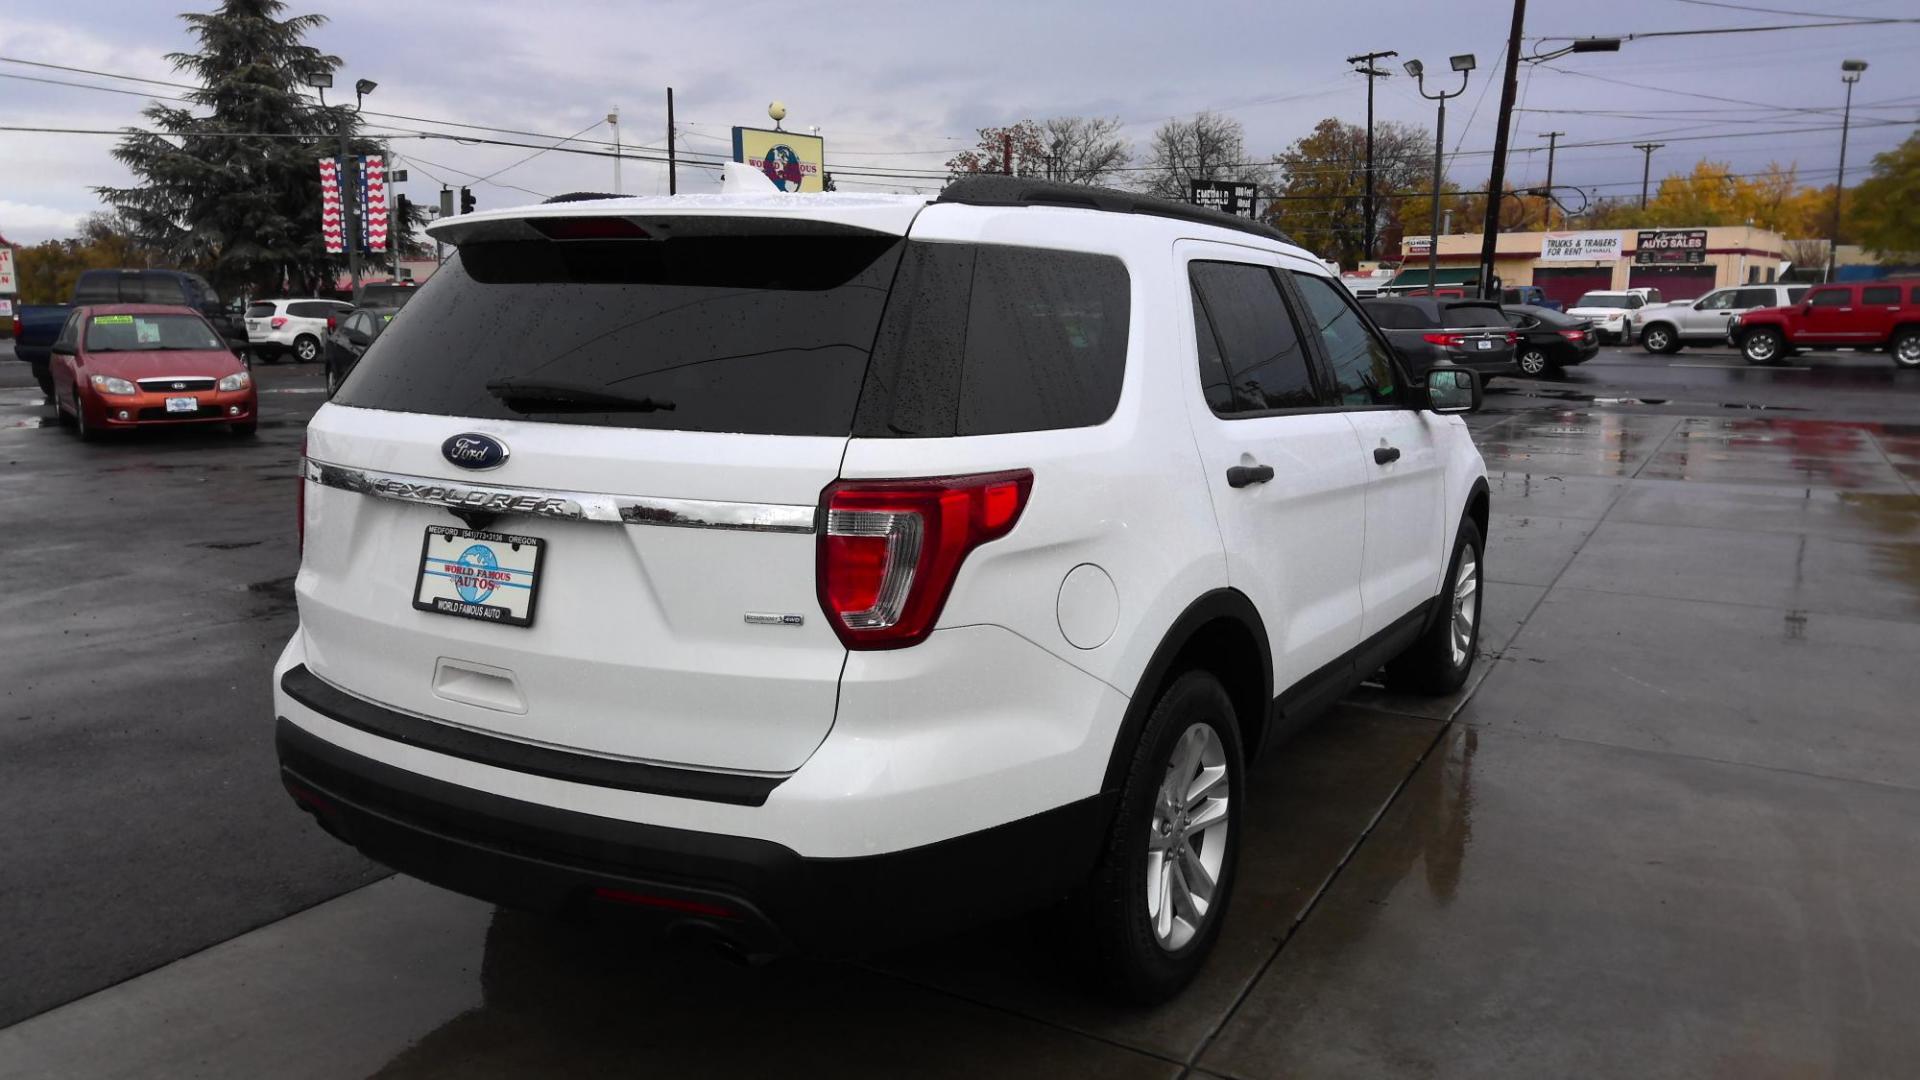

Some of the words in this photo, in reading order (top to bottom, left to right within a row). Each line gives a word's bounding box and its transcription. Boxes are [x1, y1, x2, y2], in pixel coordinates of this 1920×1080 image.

[1196, 189, 1229, 205] EMERALD
[1547, 239, 1573, 248] TRUCKS
[1584, 238, 1617, 247] TRAILERS
[1547, 247, 1561, 256] FOR
[1564, 247, 1583, 256] RENT
[1642, 239, 1669, 249] AUTO
[1670, 238, 1702, 248] SALES
[451, 438, 488, 461] Ford
[384, 483, 567, 514] EXPLORER
[428, 526, 459, 536] MEDFORD
[508, 536, 537, 545] OREGON
[444, 564, 474, 577] WORLD
[476, 569, 511, 582] FAMOUS
[455, 576, 495, 590] AUTOS
[437, 600, 459, 613] WORLD
[458, 603, 484, 616] FAMOUS
[484, 606, 501, 619] AUTO
